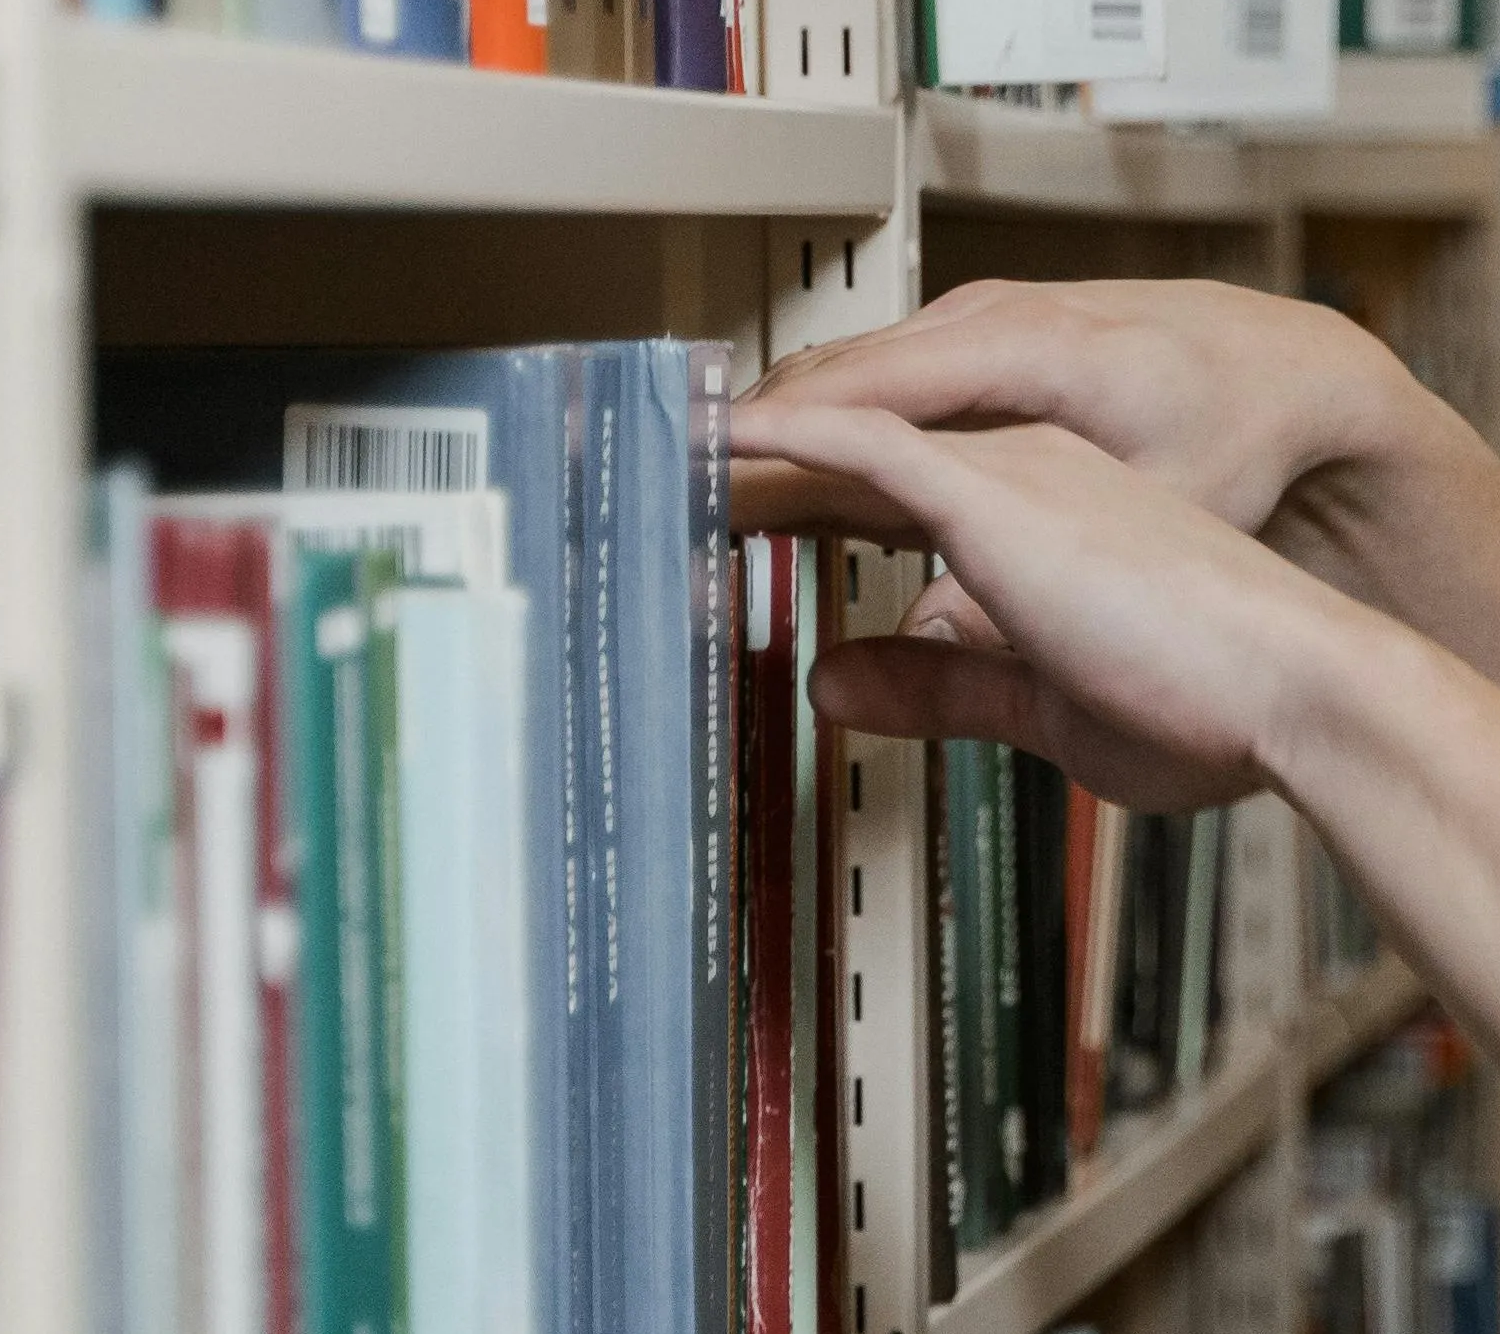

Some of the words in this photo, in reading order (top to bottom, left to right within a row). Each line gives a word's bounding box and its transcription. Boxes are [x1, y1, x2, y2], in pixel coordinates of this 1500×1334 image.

[706, 401, 718, 515] КУРС
[706, 530, 718, 818] УГОЛОВНОГО
[706, 832, 718, 984] ПРАВА
